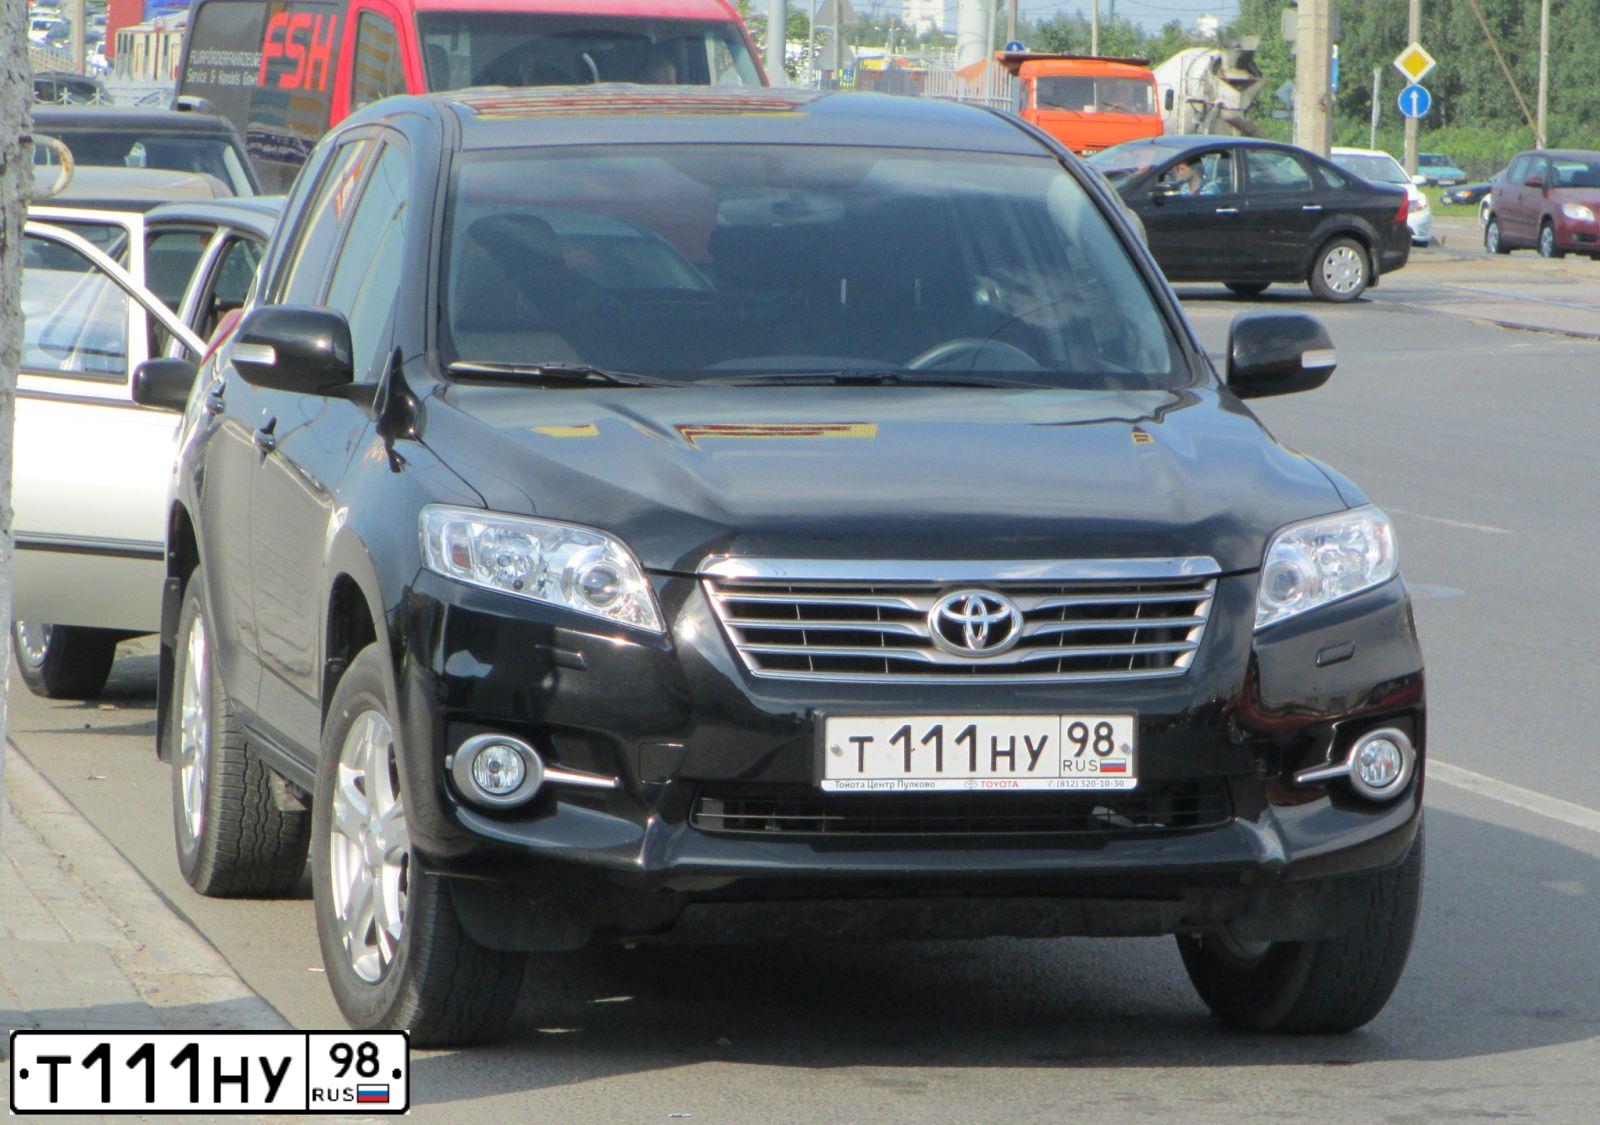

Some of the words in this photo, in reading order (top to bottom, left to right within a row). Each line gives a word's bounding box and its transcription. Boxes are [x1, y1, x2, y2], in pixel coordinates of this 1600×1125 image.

[257, 10, 338, 92] FSH
[1066, 720, 1115, 758] 98
[1062, 759, 1099, 772] RUS
[835, 780, 865, 789] Тойота
[867, 781, 896, 790] Центр
[897, 780, 935, 790] Пулково
[980, 780, 1019, 789] TOYOTA
[1056, 780, 1079, 789] (812)
[1081, 779, 1125, 788] 320-10-30
